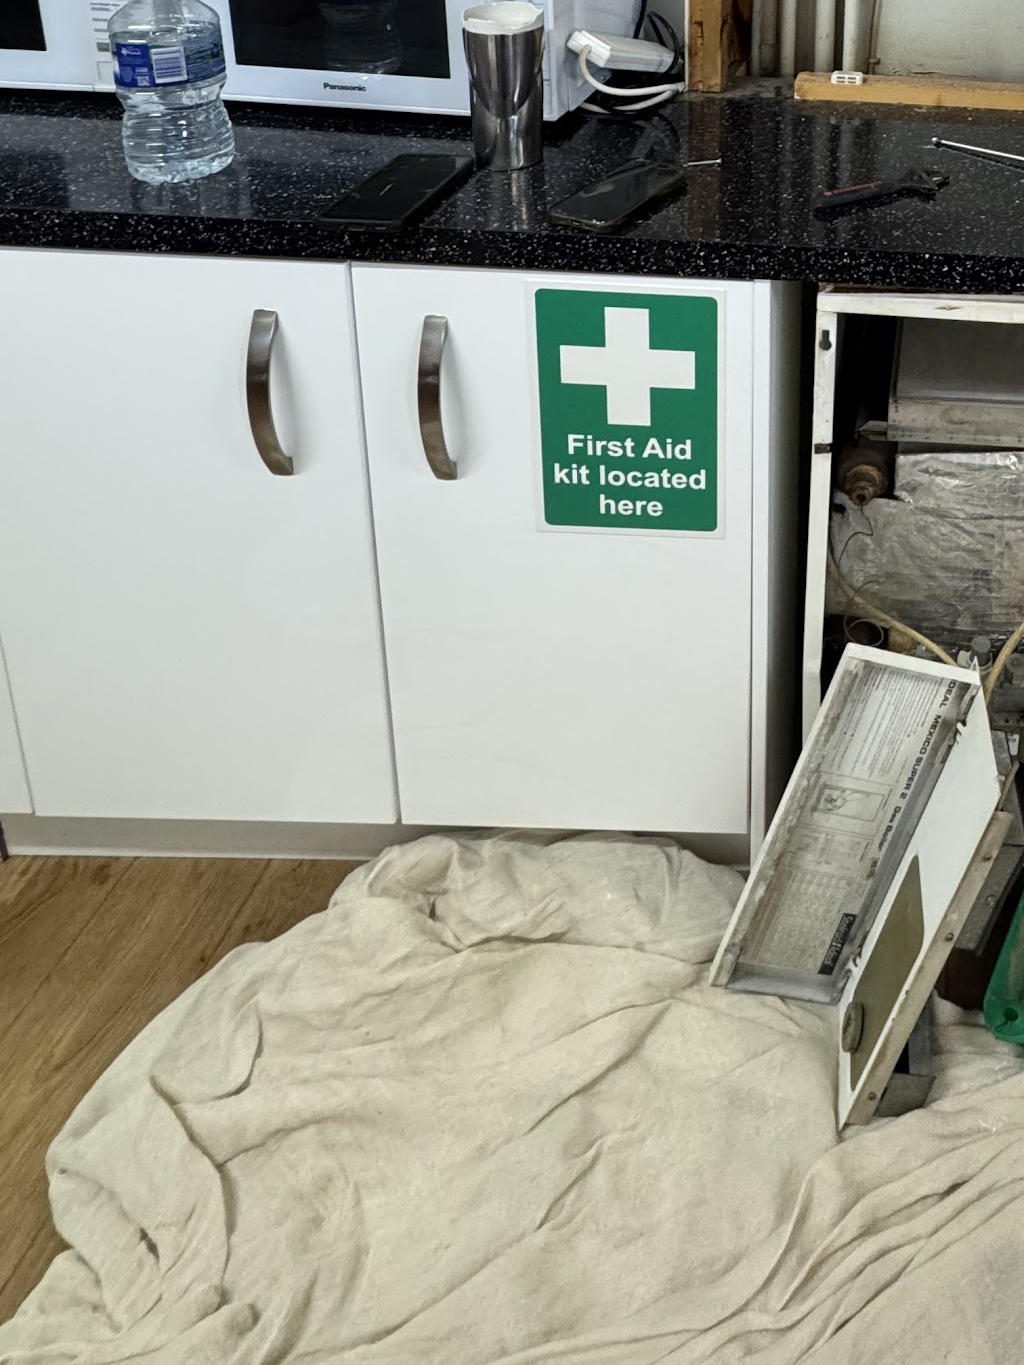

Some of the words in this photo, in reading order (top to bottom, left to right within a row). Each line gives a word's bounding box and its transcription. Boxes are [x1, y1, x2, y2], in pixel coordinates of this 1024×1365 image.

[323, 82, 367, 92] Panasonic
[567, 434, 635, 457] First
[642, 438, 692, 460] Aid
[554, 463, 590, 485] kit
[599, 465, 706, 490] located
[599, 494, 663, 516] here
[920, 714, 941, 755] MEXICO
[904, 757, 923, 790] SUPER
